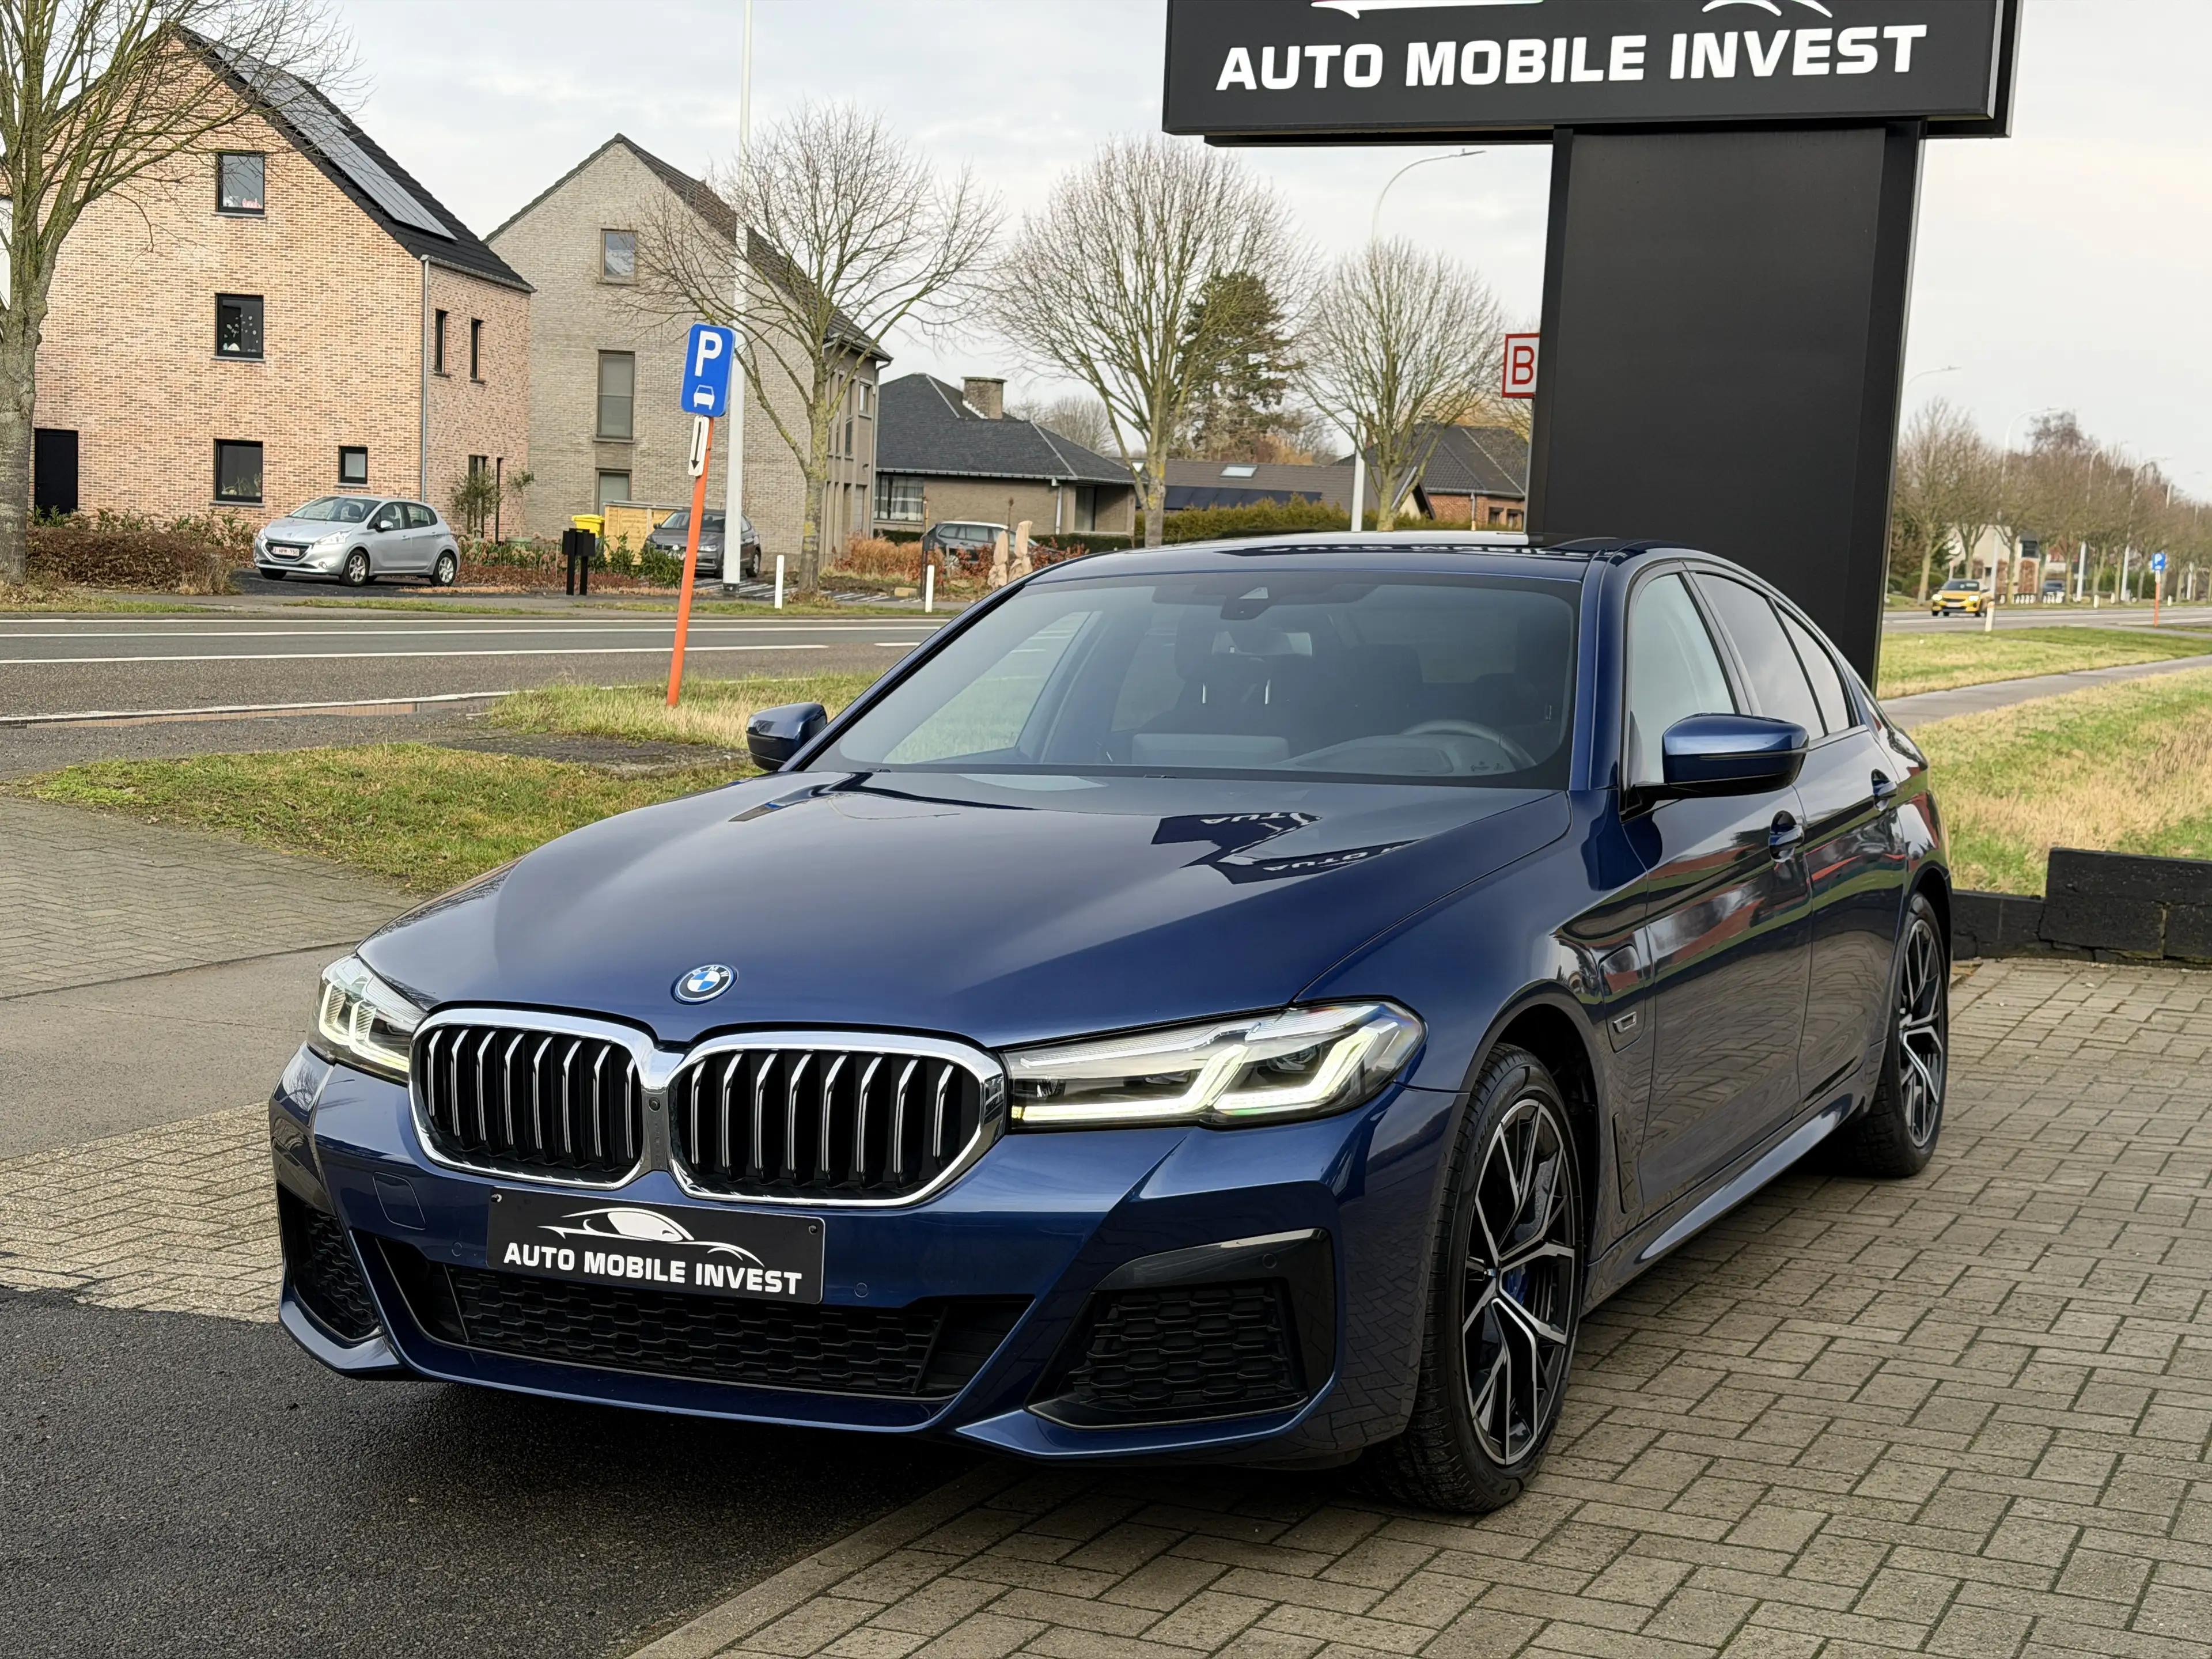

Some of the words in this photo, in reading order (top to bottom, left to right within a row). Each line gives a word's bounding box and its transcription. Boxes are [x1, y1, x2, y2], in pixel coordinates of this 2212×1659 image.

[1215, 43, 1383, 90] AUTO
[1406, 35, 1647, 86] MOBILE
[1669, 24, 1927, 79] INVEST
[695, 330, 722, 377] P
[1512, 346, 1535, 385] B
[503, 1242, 575, 1271] AUTO
[584, 1251, 686, 1283] MOBILE
[695, 1263, 802, 1295] INVEST
